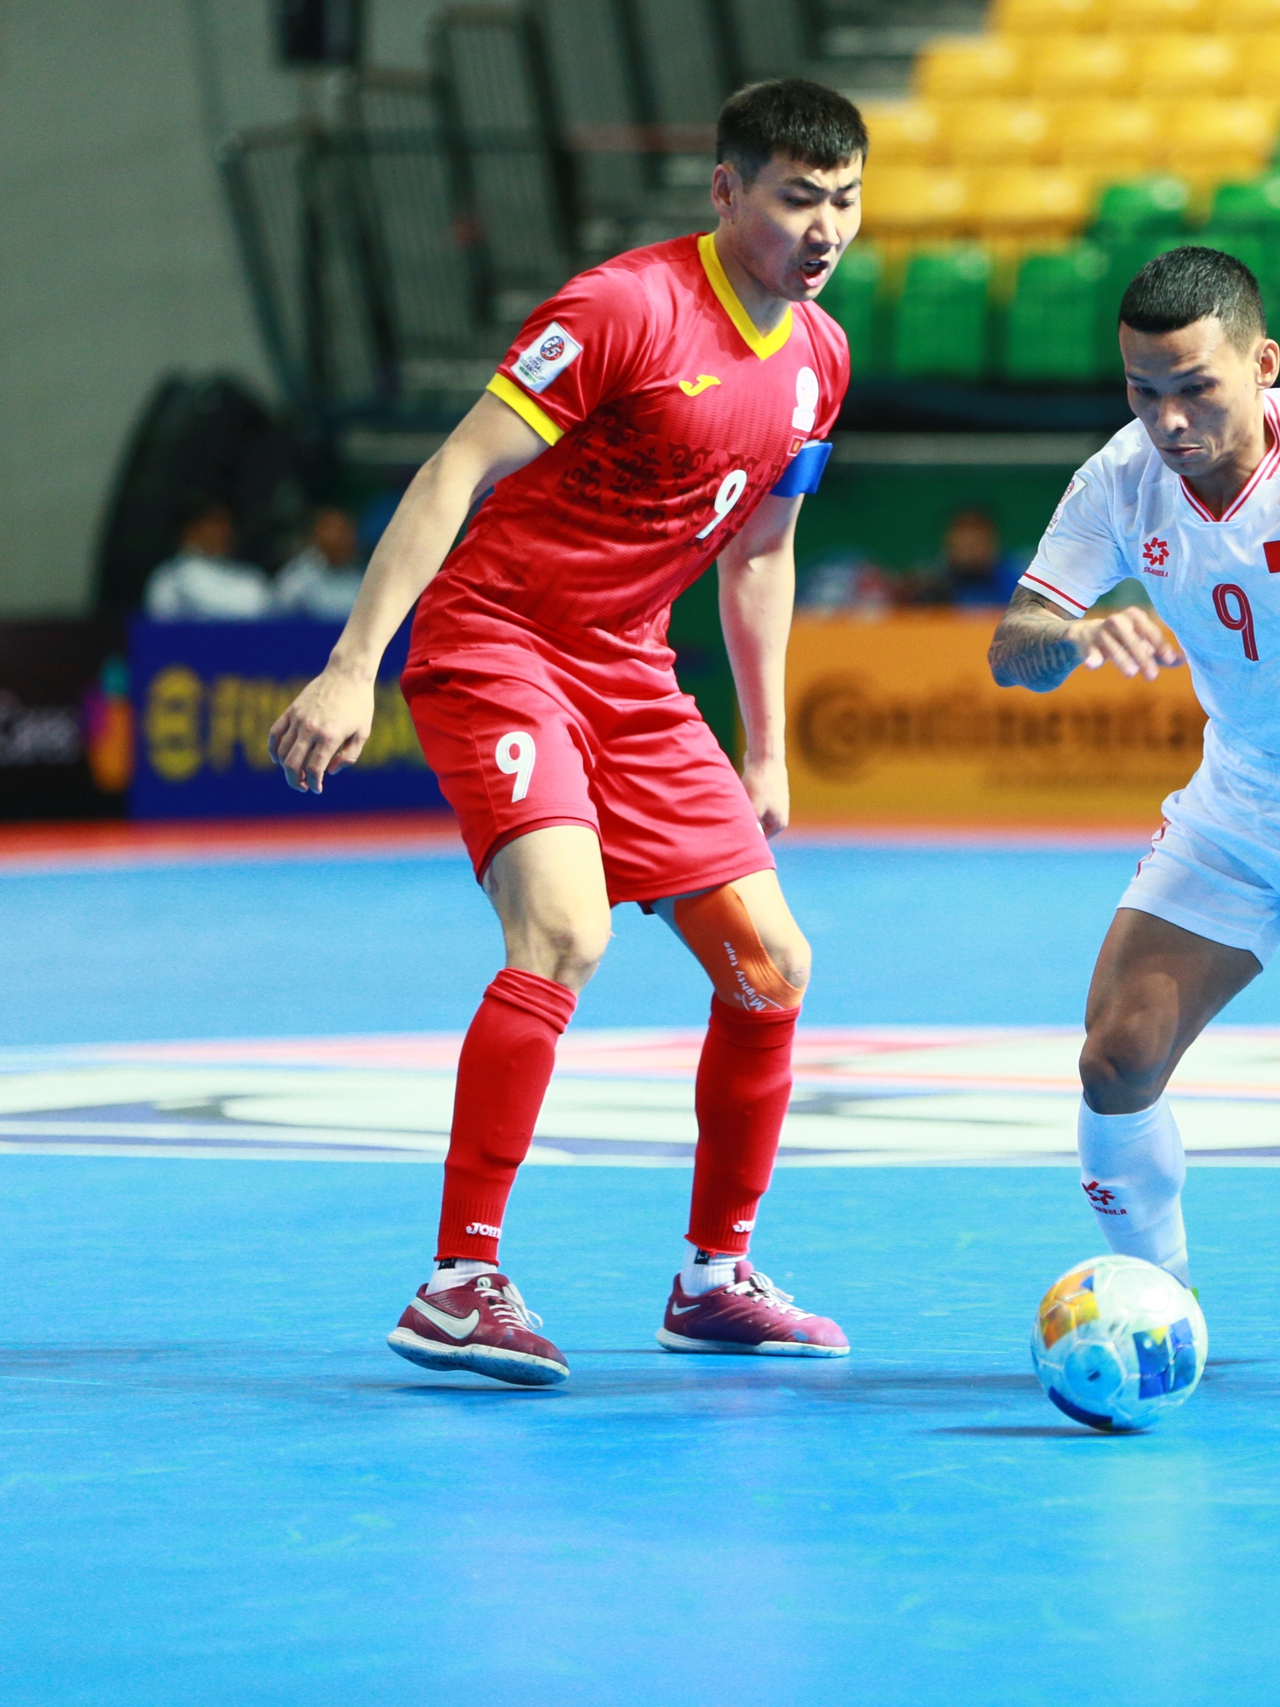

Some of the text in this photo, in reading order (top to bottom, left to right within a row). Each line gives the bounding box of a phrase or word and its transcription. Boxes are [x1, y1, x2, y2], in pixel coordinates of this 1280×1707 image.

[695, 468, 748, 540] 9
[1212, 582, 1260, 662] 9
[495, 730, 537, 804] 9
[735, 970, 767, 1012] Mighty
[465, 1222, 502, 1239] Jom
